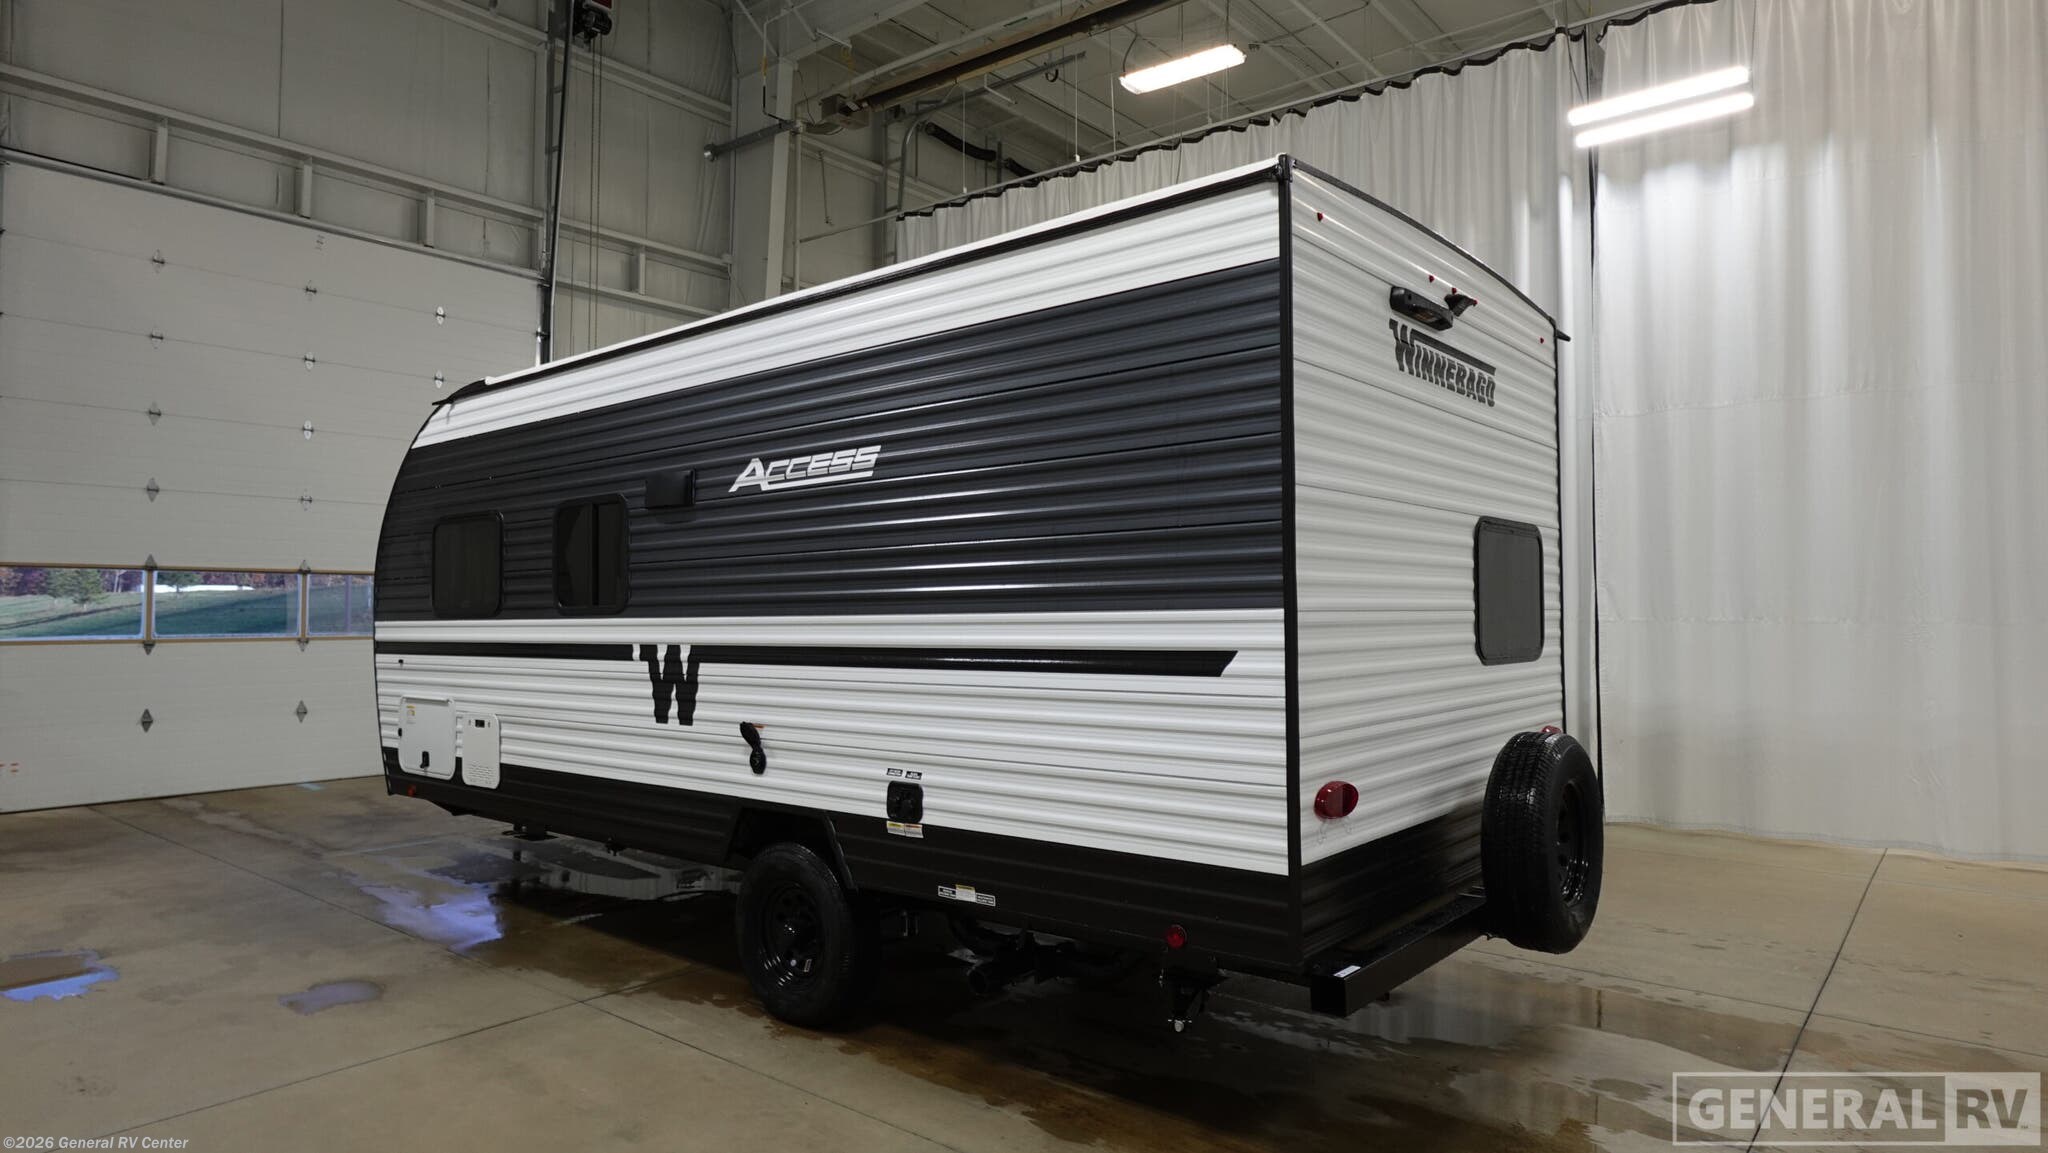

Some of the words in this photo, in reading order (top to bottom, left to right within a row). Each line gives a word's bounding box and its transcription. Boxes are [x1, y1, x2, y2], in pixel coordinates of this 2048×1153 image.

[1389, 318, 1497, 407] WINNEBAGO
[728, 445, 882, 493] ACCESS
[636, 644, 701, 726] W
